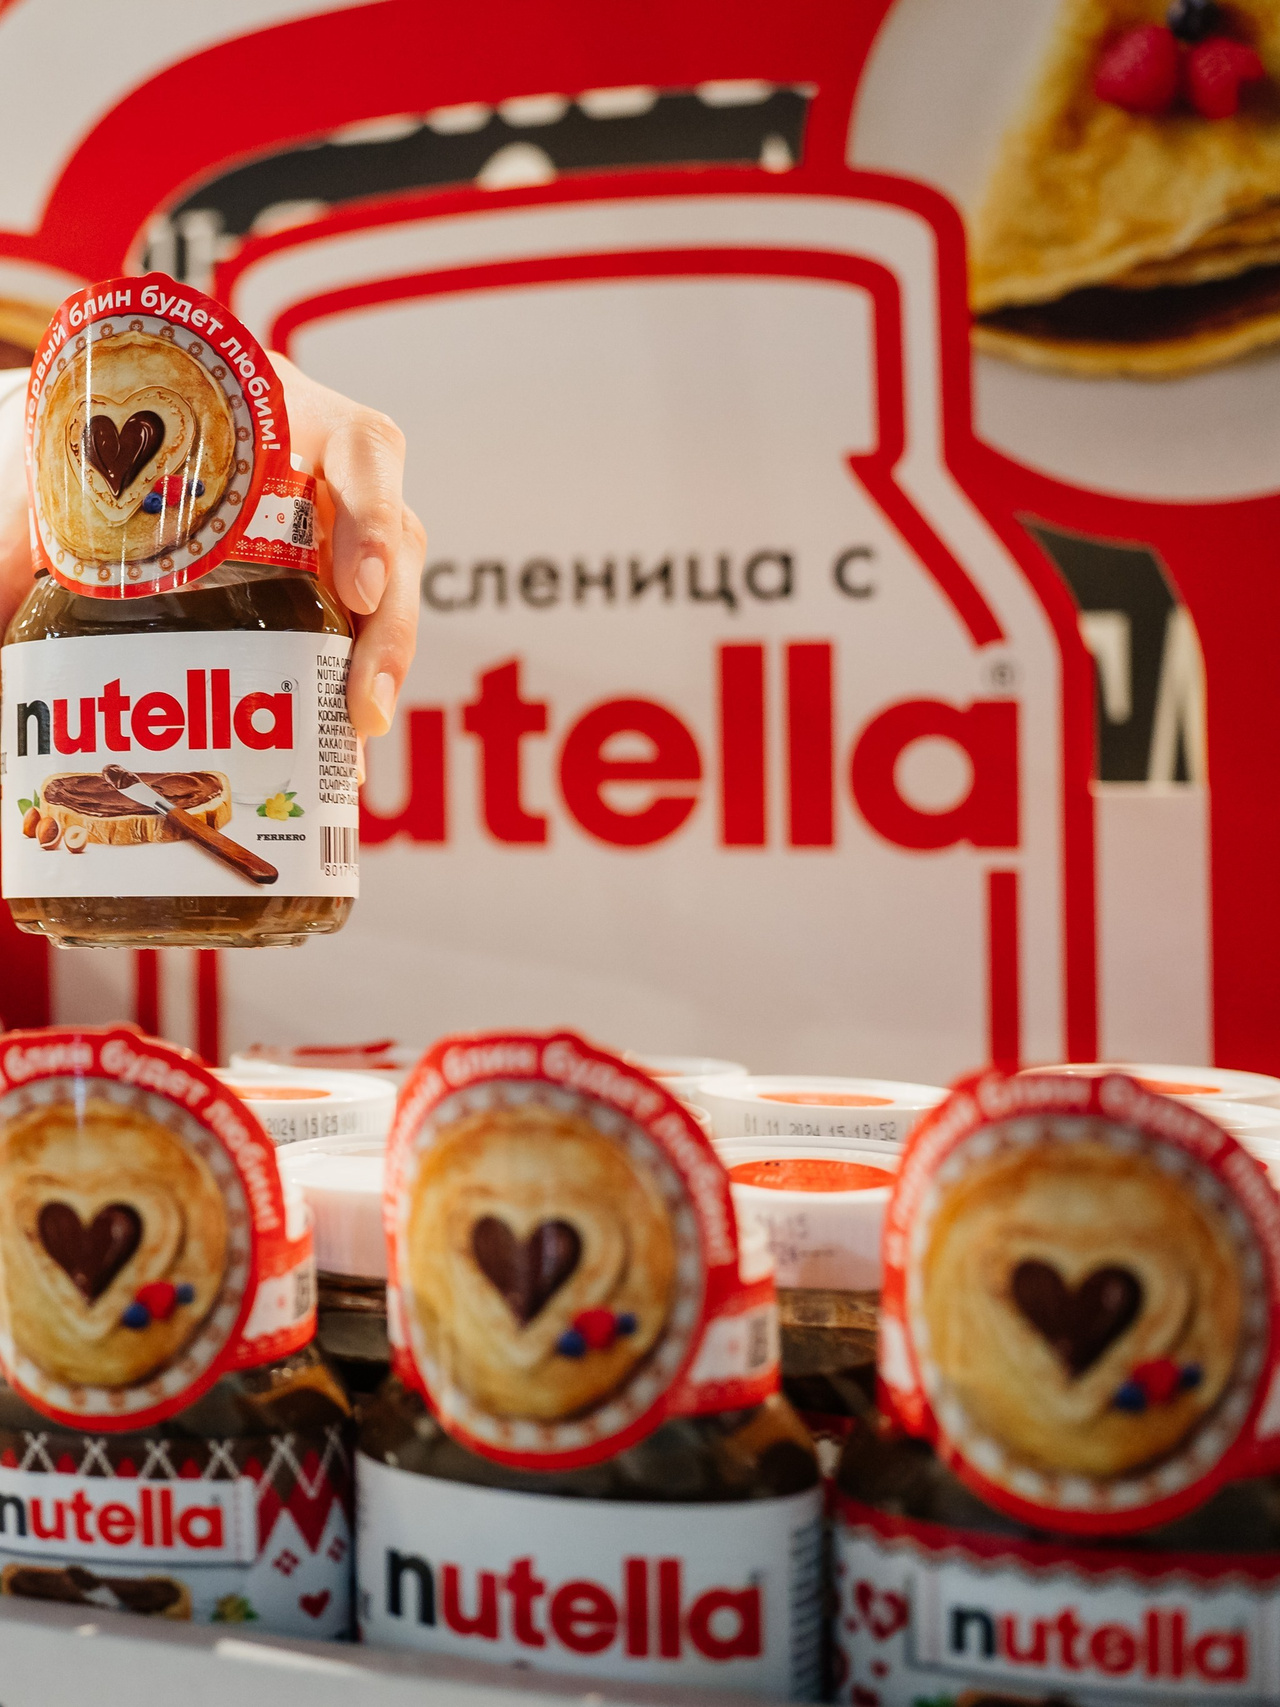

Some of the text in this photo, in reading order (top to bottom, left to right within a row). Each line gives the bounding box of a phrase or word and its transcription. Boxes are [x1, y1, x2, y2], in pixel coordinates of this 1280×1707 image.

[68, 289, 131, 327] блин
[140, 285, 223, 337] будет
[220, 336, 282, 452] любим!
[424, 544, 881, 614] сленица с
[316, 655, 340, 668] ПАСТА
[16, 669, 294, 758] nutella
[358, 638, 1021, 853] utella
[256, 833, 306, 842] FERRERO
[385, 1545, 764, 1663] nutella
[951, 1606, 1248, 1685] nutella
